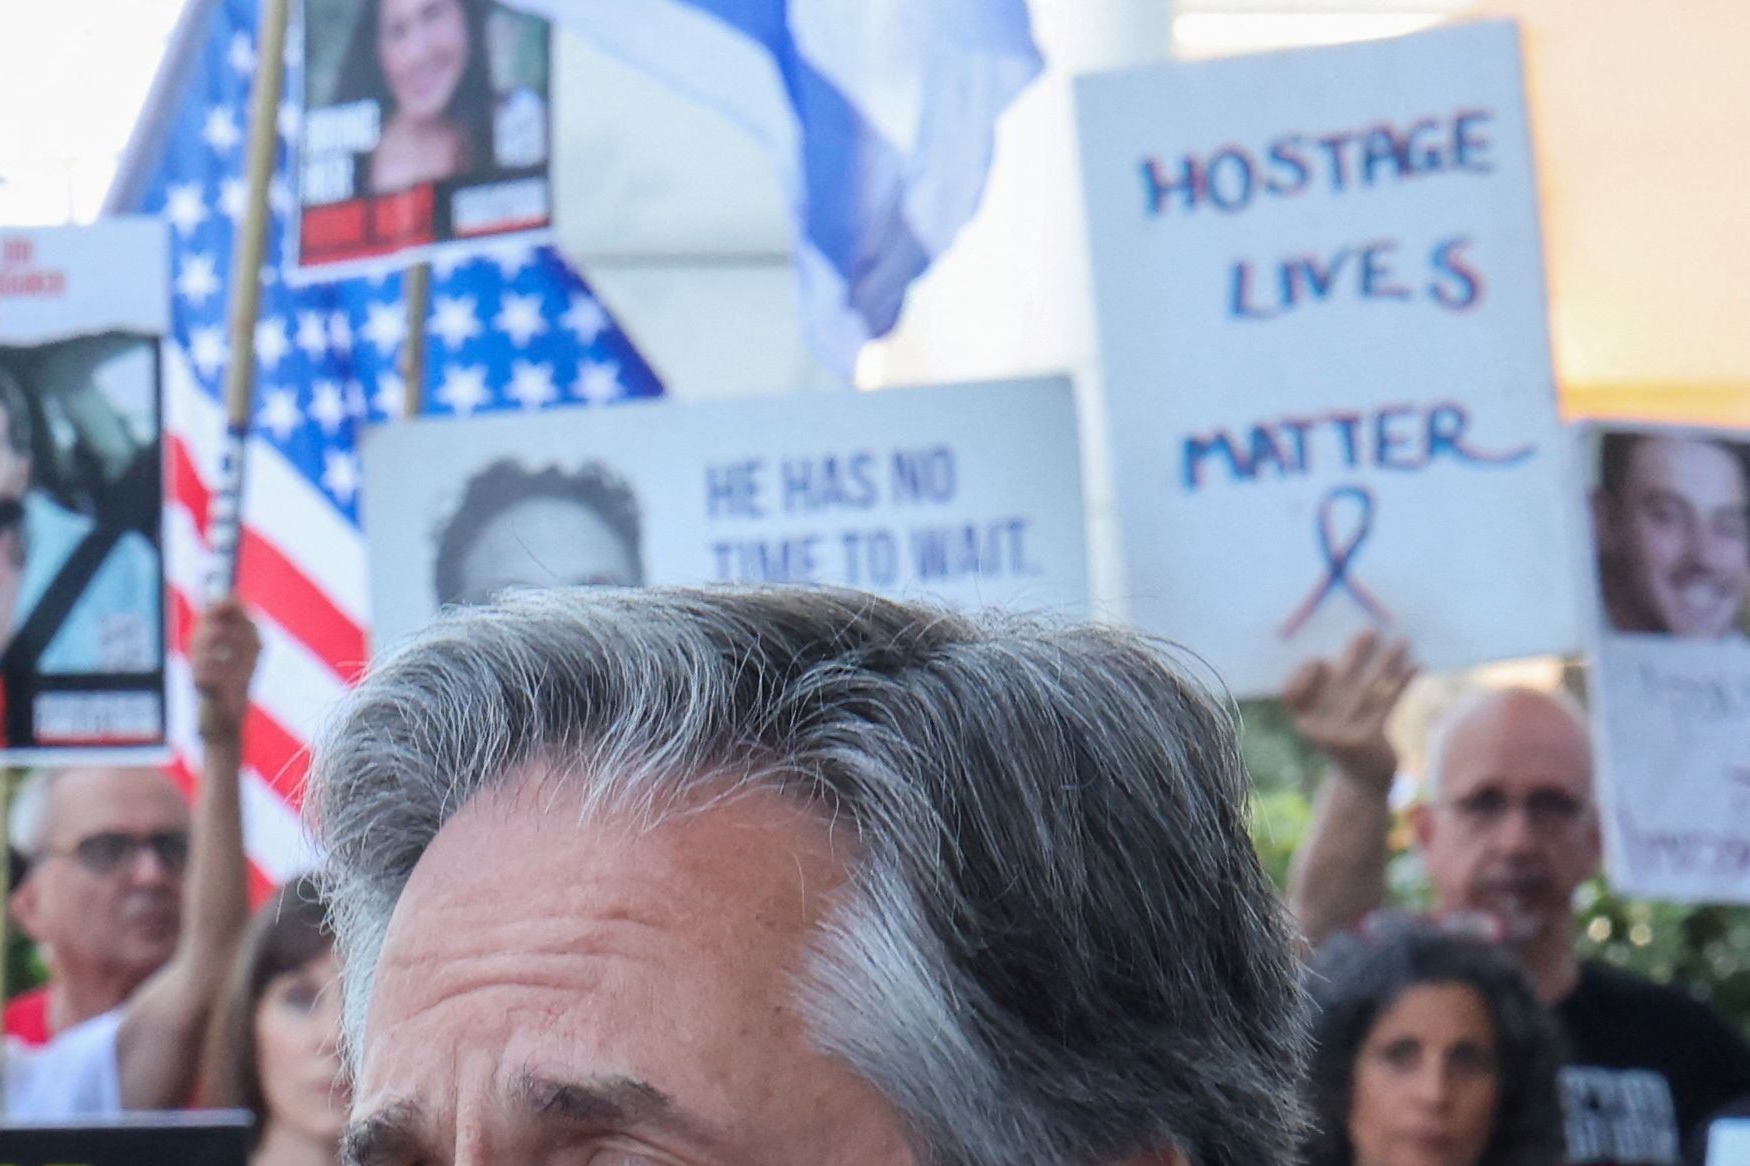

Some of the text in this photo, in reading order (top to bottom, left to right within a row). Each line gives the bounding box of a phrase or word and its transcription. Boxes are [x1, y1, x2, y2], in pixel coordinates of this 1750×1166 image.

[1138, 107, 1496, 220] HOSTAGE
[1227, 234, 1486, 321] LIVES
[705, 441, 958, 521] HE HAS NO
[1180, 401, 1538, 492] MATTER
[710, 533, 825, 584] TIME
[842, 526, 900, 587] TO
